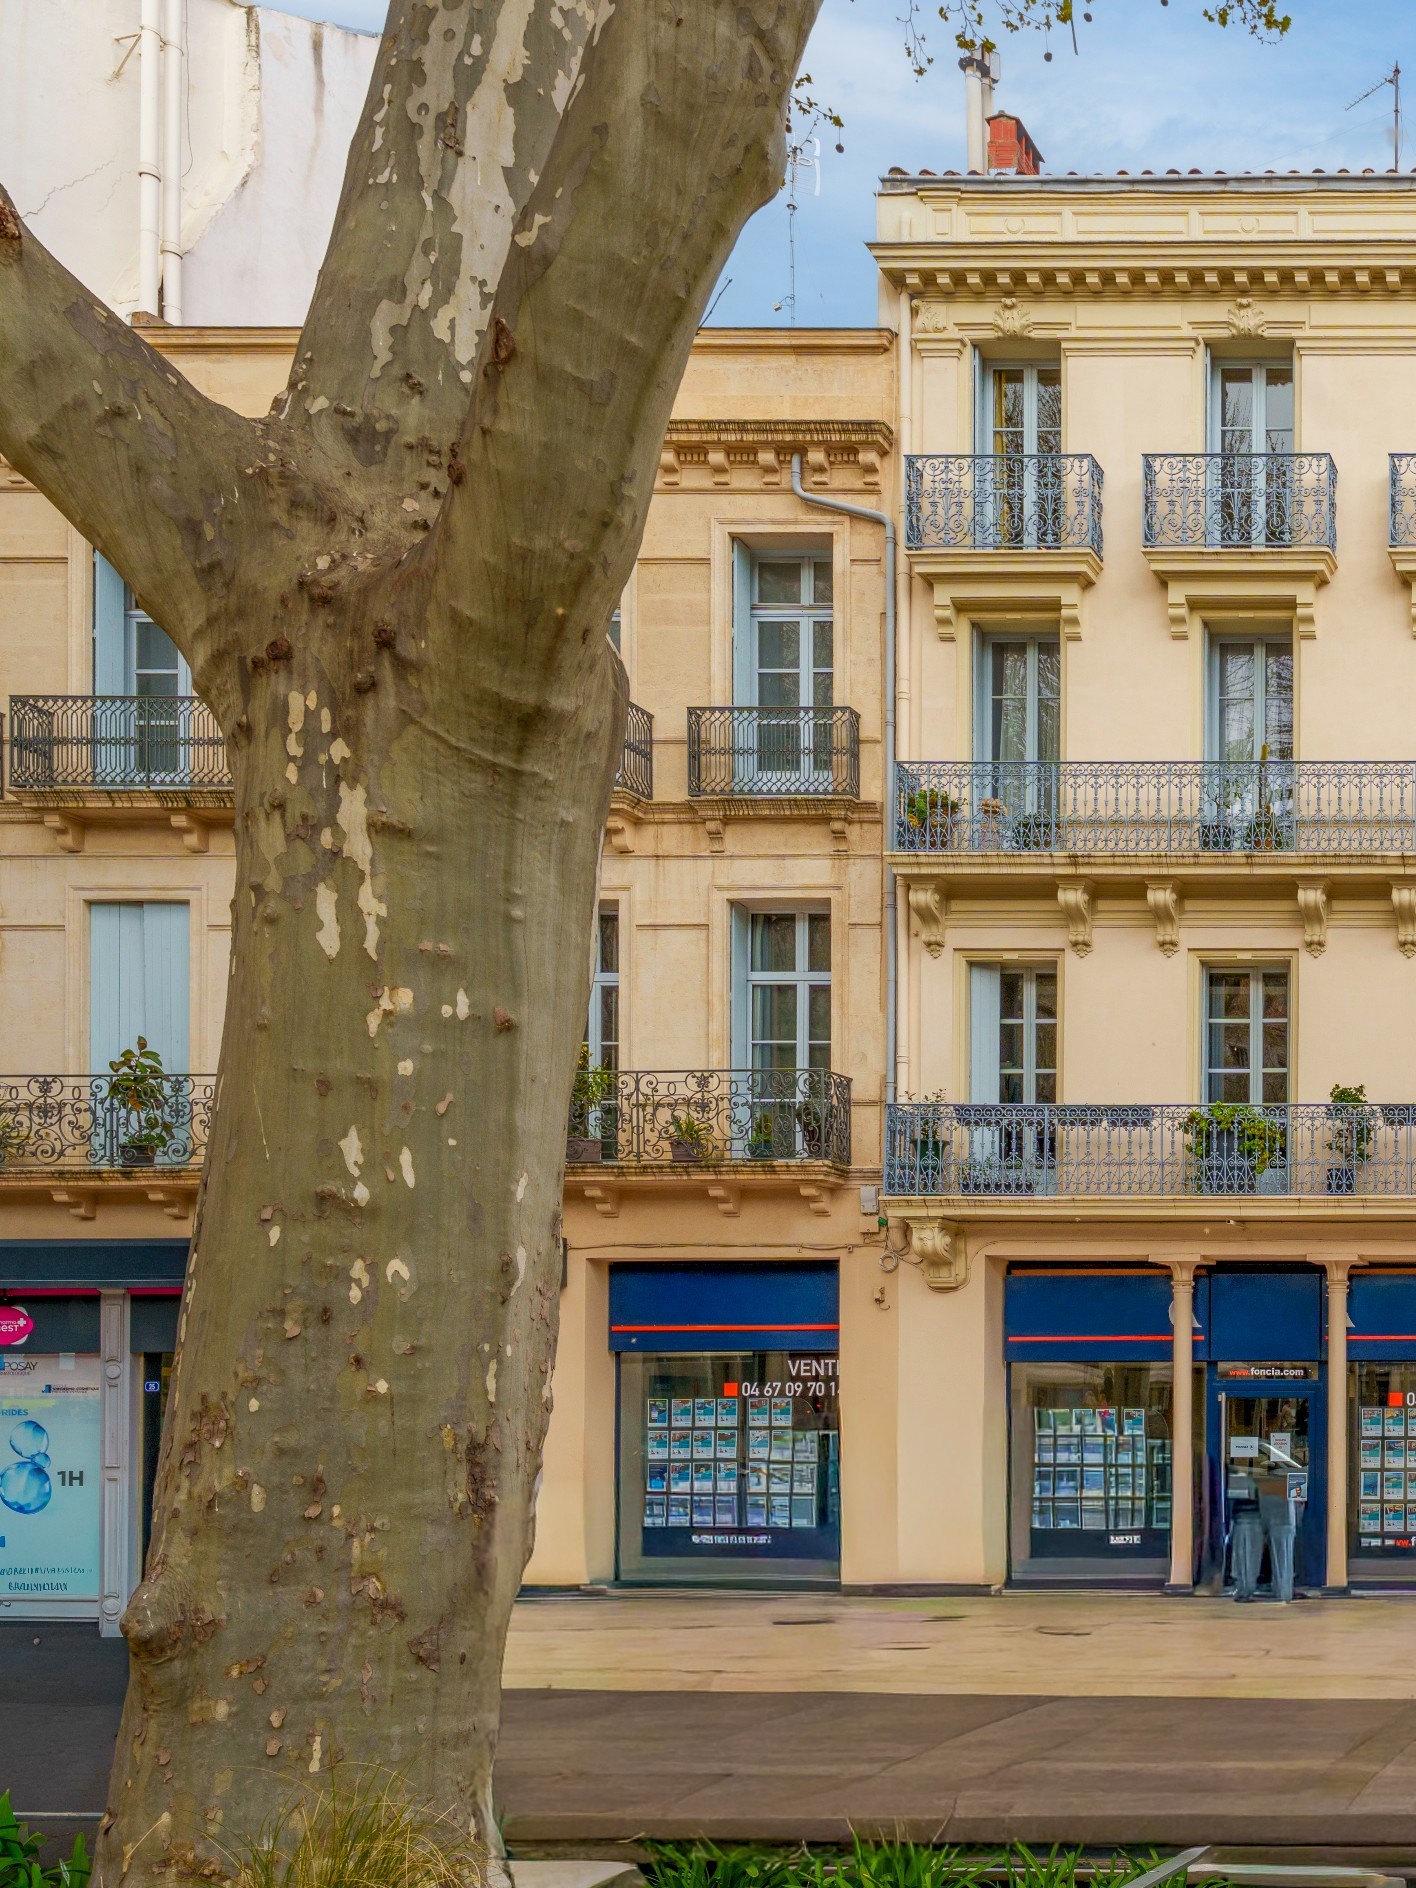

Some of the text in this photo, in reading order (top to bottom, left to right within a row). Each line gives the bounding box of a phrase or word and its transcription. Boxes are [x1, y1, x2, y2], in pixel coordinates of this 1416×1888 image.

[4, 1361, 38, 1371] POSAY
[788, 1360, 840, 1376] VENT
[1229, 1367, 1304, 1376] www.foncia.com
[742, 1382, 840, 1396] 04 67 09 70 1
[57, 1470, 84, 1487] 1H
